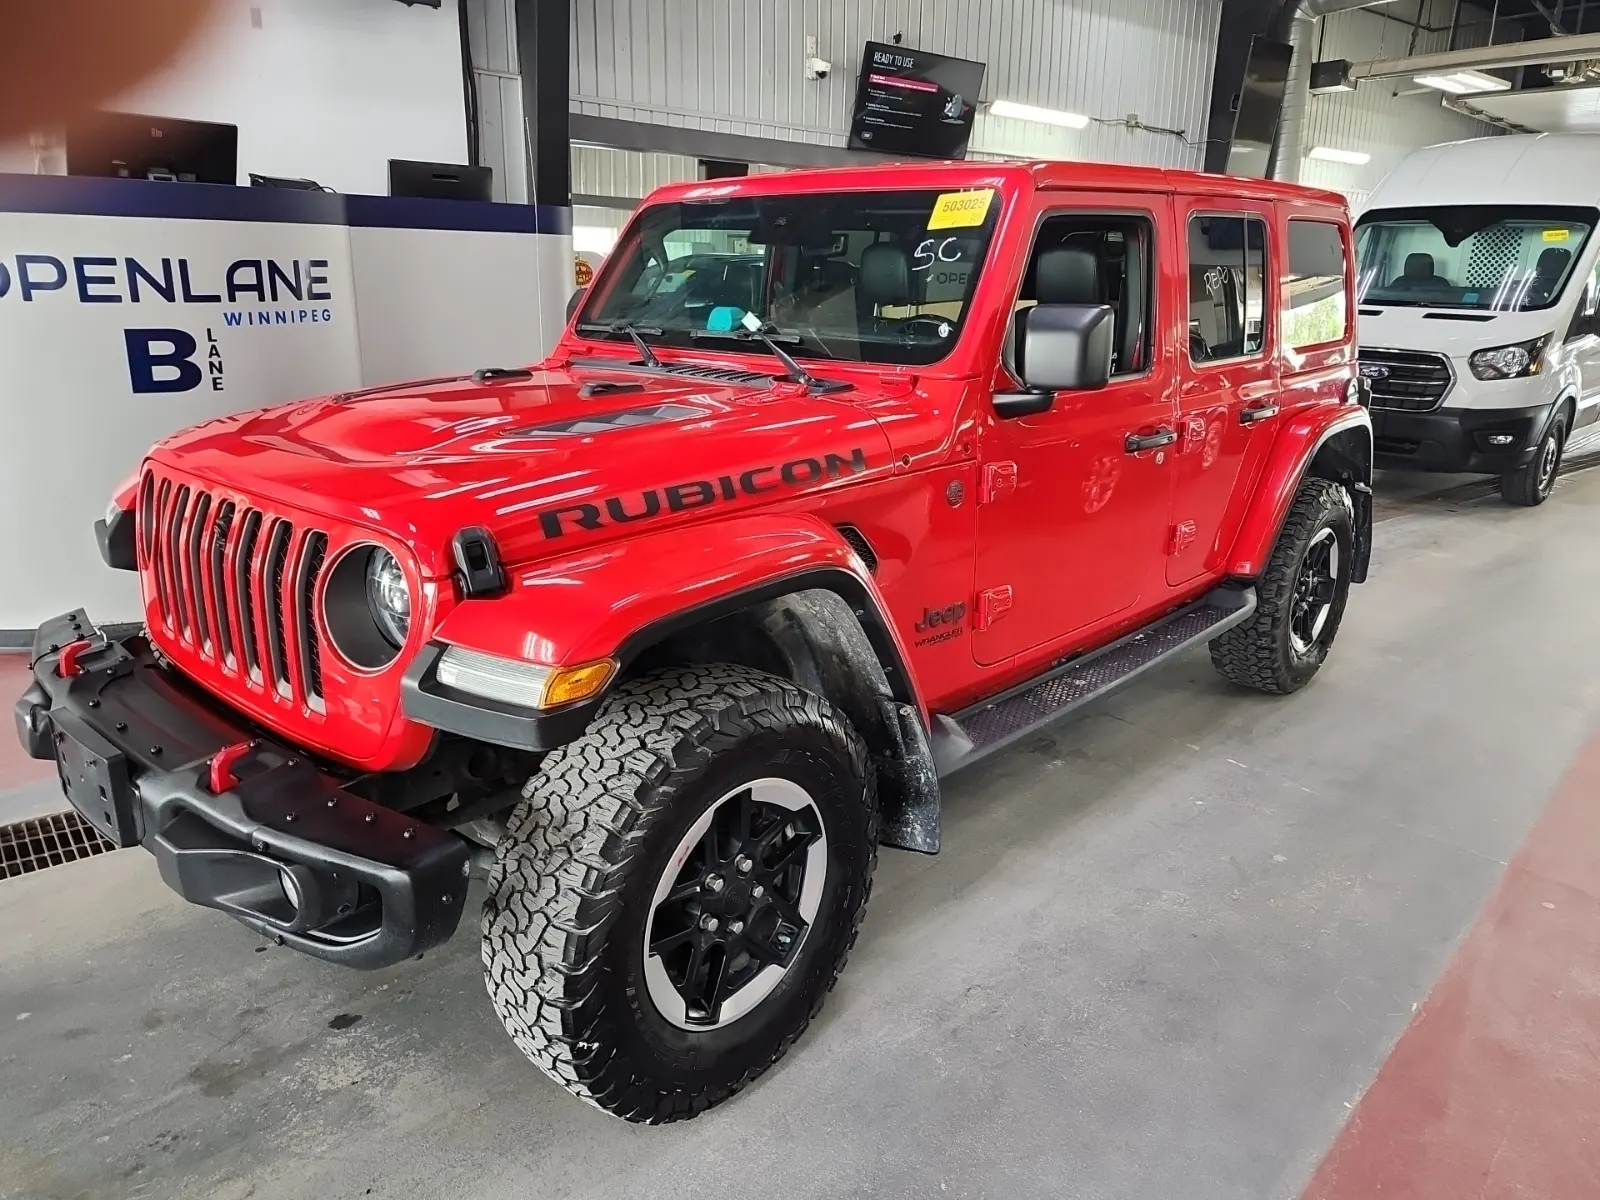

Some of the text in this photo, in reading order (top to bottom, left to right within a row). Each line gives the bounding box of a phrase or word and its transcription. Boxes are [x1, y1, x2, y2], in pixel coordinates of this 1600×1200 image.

[873, 51, 894, 65] READY
[894, 56, 902, 66] TO
[903, 57, 915, 68] USE
[942, 198, 987, 213] 503025
[0, 254, 332, 303] PENLANE
[937, 272, 969, 285] OPE
[223, 308, 332, 326] WINNIPEG
[124, 328, 224, 393] B LANE
[537, 448, 867, 540] RUBICON
[914, 601, 966, 633] Jeep
